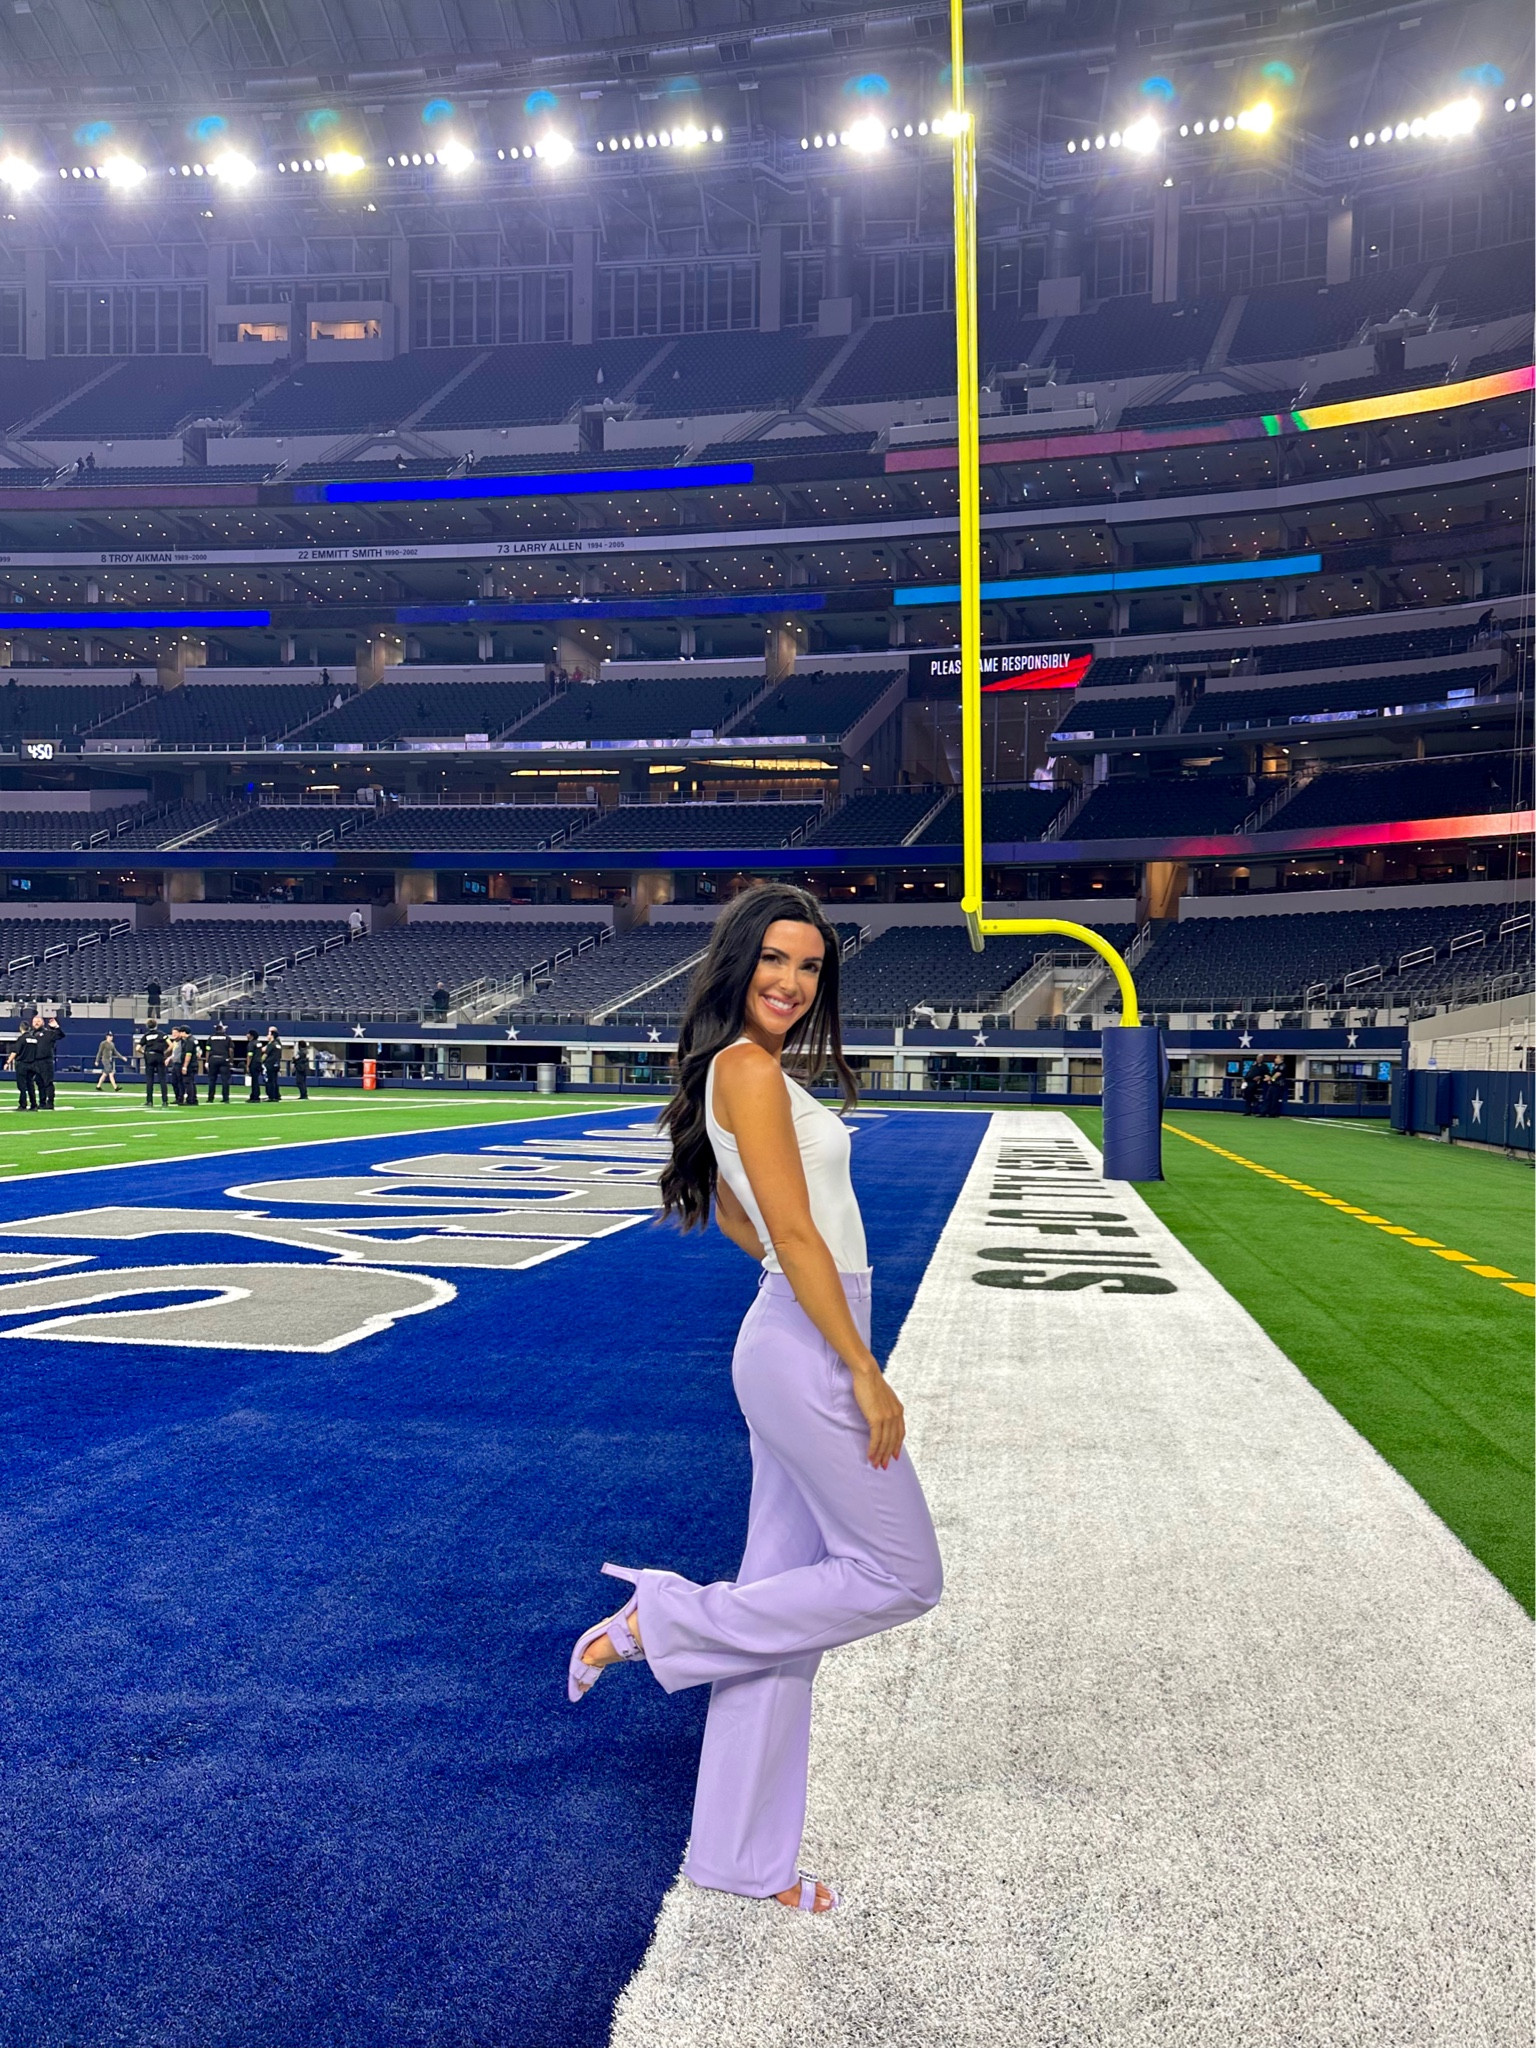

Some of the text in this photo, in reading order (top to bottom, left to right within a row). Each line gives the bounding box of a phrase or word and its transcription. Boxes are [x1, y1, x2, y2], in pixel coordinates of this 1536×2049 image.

[100, 554, 107, 563] 8
[109, 553, 133, 563] TROY
[135, 552, 172, 563] AIKMAN
[298, 550, 309, 560] 22
[311, 549, 350, 559] EMMITT
[352, 548, 383, 558] SMITH
[497, 544, 510, 554] 73
[513, 543, 547, 553] LARRY
[549, 541, 582, 552] ALLEN
[930, 653, 1071, 676] PLEAS AME RESPONSIBLY
[994, 1145, 1095, 1172] TAKES
[989, 1174, 1115, 1200] ALL
[985, 1209, 1139, 1238] OF
[972, 1247, 1178, 1295] US
